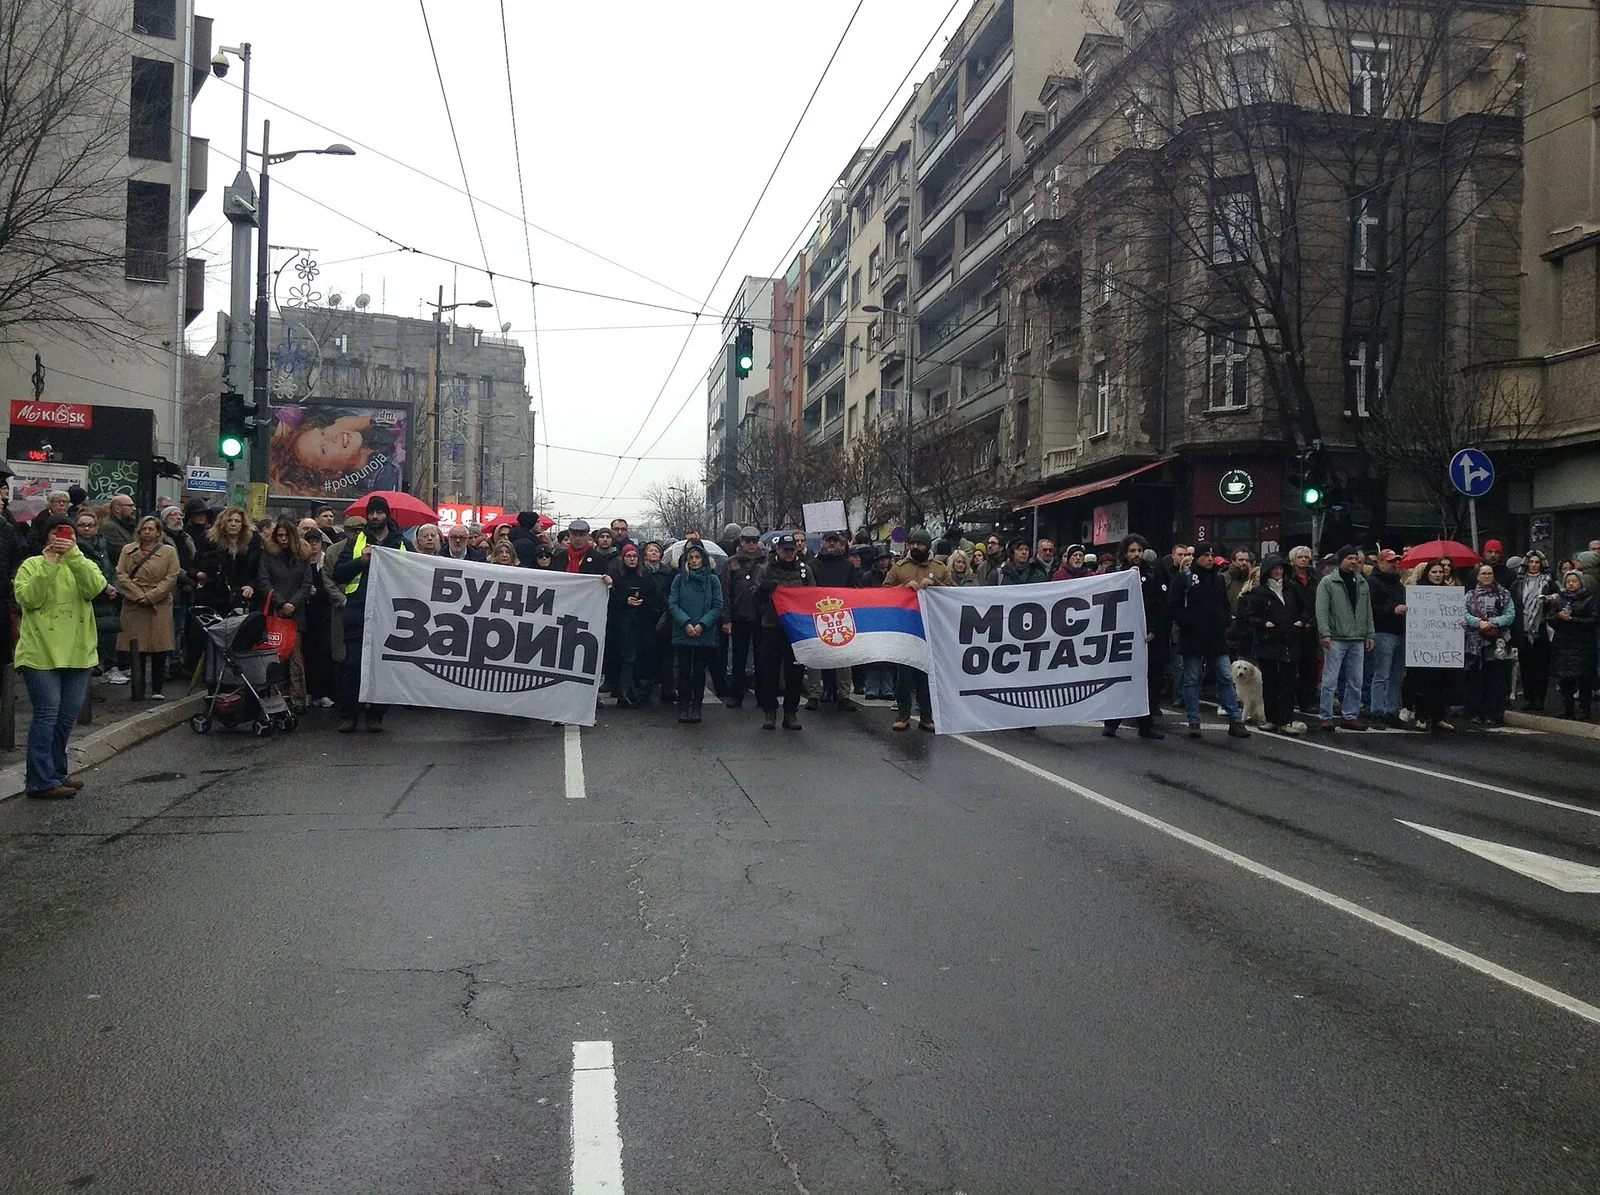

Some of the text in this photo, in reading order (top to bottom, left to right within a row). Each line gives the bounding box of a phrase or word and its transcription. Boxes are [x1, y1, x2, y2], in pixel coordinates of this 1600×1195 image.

[191, 470, 210, 478] BTA
[324, 453, 387, 492] #potpunoja
[430, 568, 555, 616] Буди
[384, 598, 600, 675] Зарић
[959, 588, 1129, 645] МОСТ
[962, 631, 1135, 675] ОСТАЈЕ
[1413, 650, 1463, 664] POWER
